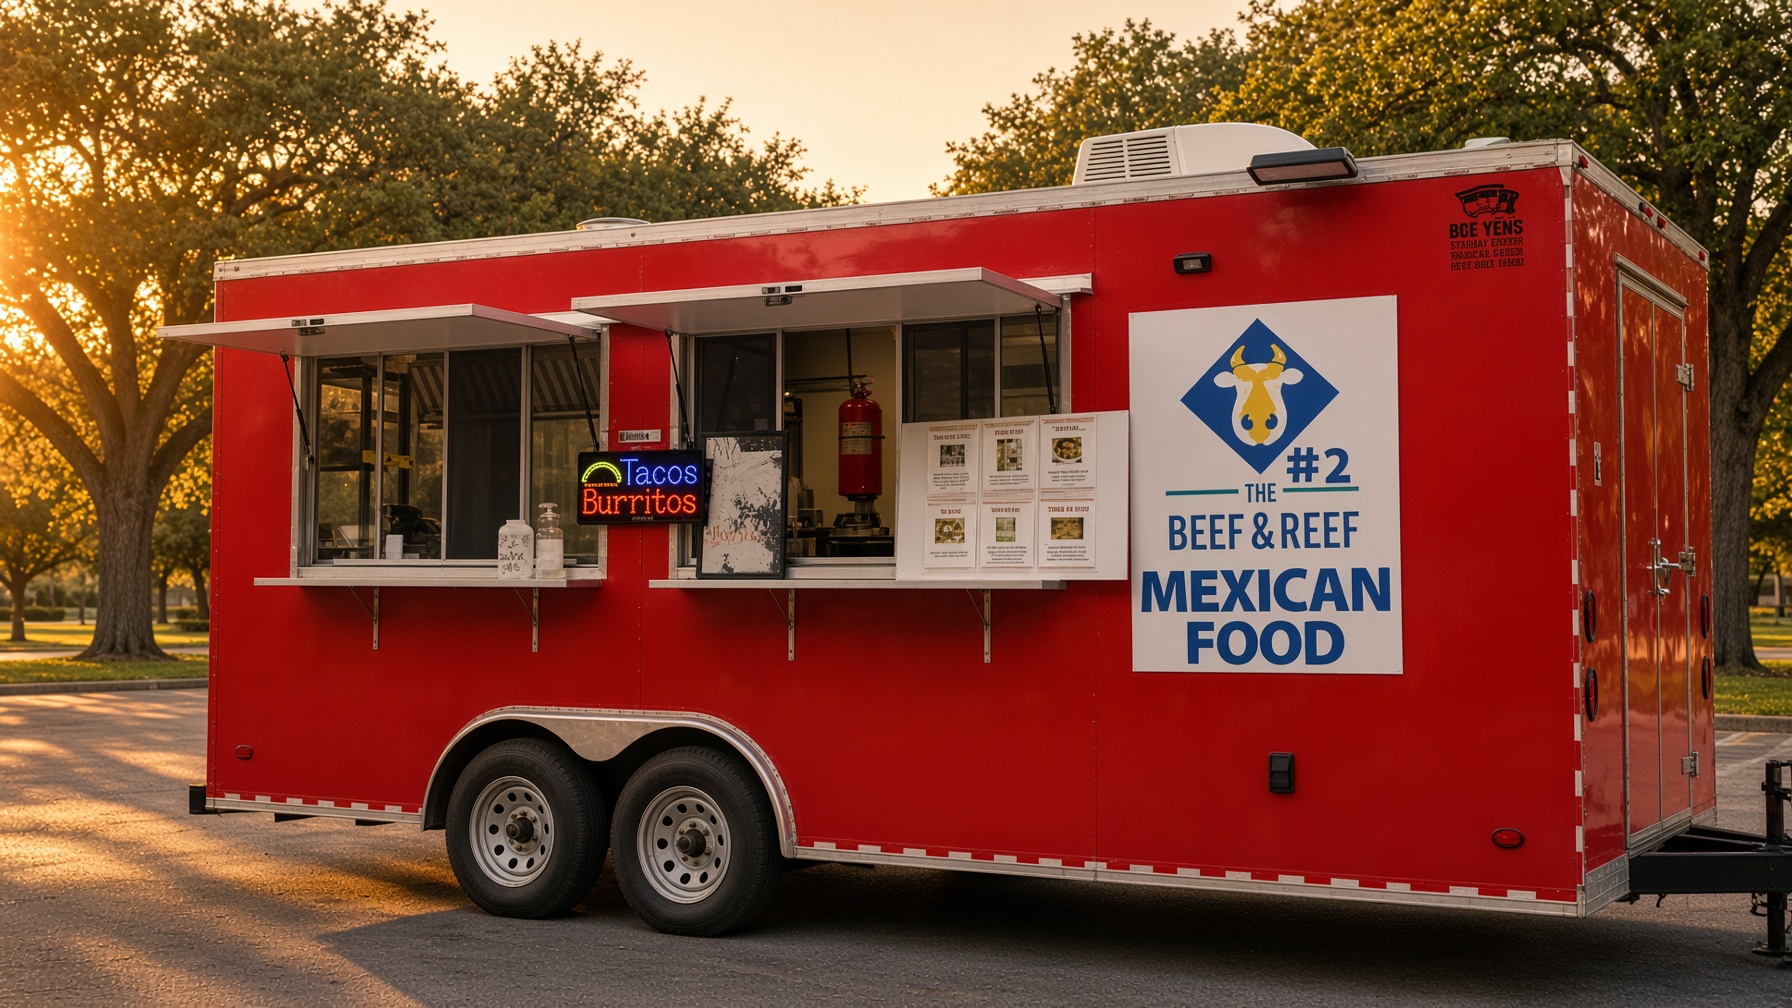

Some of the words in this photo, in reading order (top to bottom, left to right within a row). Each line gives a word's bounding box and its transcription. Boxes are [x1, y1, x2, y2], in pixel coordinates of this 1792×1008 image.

[1483, 219, 1523, 236] YENS
[619, 458, 698, 486] Tacos
[1286, 447, 1351, 484] #2
[582, 488, 697, 515] Burritos
[1245, 483, 1277, 503] THE
[1168, 513, 1245, 551] BEEF
[1251, 511, 1275, 550] &
[1280, 511, 1360, 549] REEF
[1141, 567, 1391, 612] MEXICAN
[1187, 620, 1345, 665] FOOD
